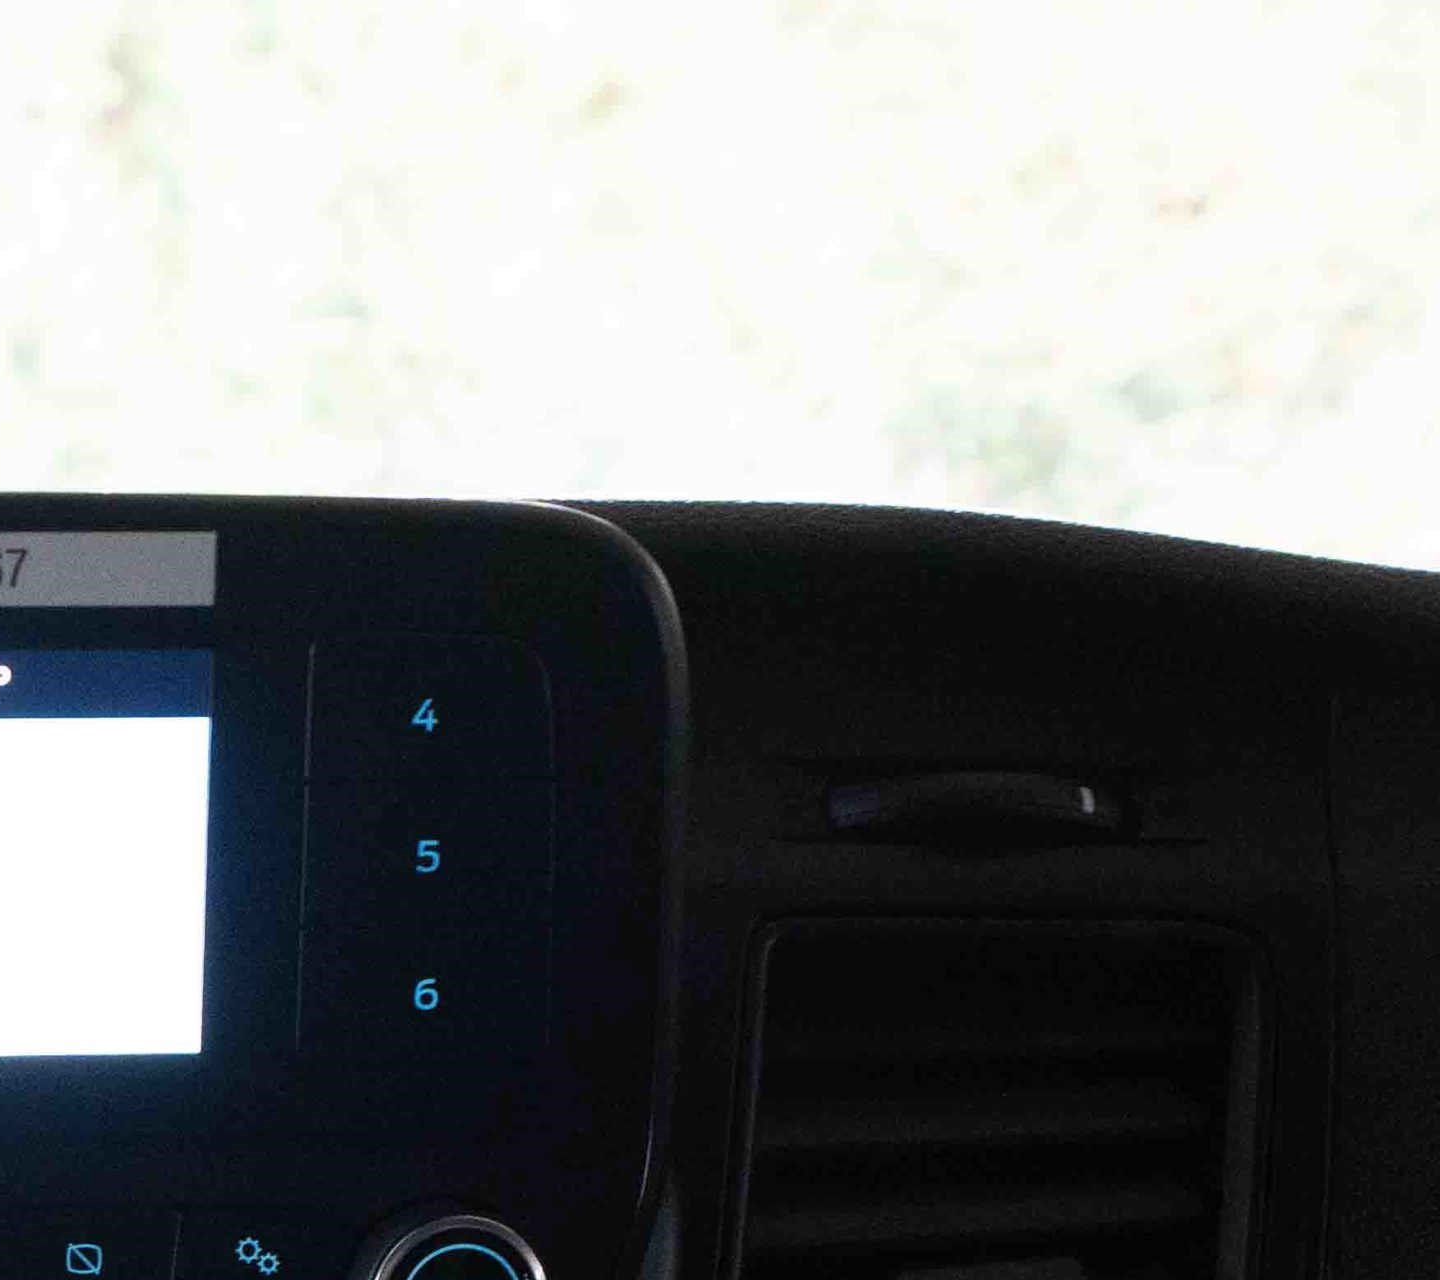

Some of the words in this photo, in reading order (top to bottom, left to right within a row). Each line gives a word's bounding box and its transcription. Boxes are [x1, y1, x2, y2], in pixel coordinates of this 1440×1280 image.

[412, 699, 437, 731] 4
[416, 840, 439, 872] 5
[414, 979, 438, 1010] 6
